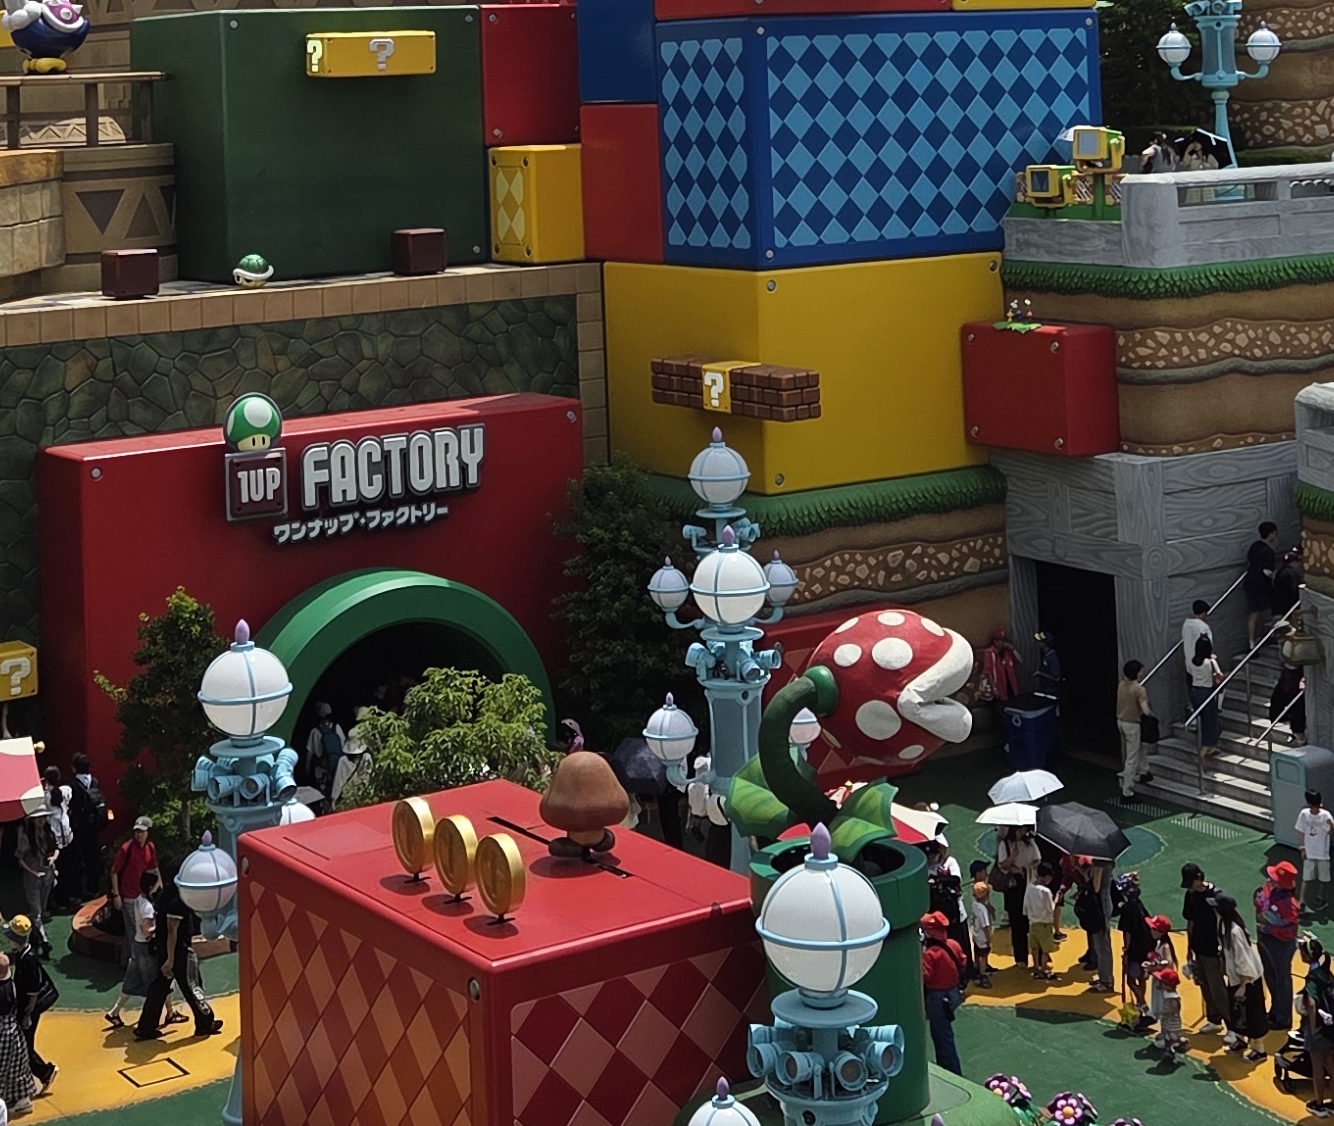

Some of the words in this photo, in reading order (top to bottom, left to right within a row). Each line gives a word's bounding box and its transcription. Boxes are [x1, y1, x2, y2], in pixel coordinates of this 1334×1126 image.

[237, 466, 281, 505] 1UP
[302, 426, 485, 508] FACTORY
[273, 502, 449, 544] ワンナップ・ファクトリー
